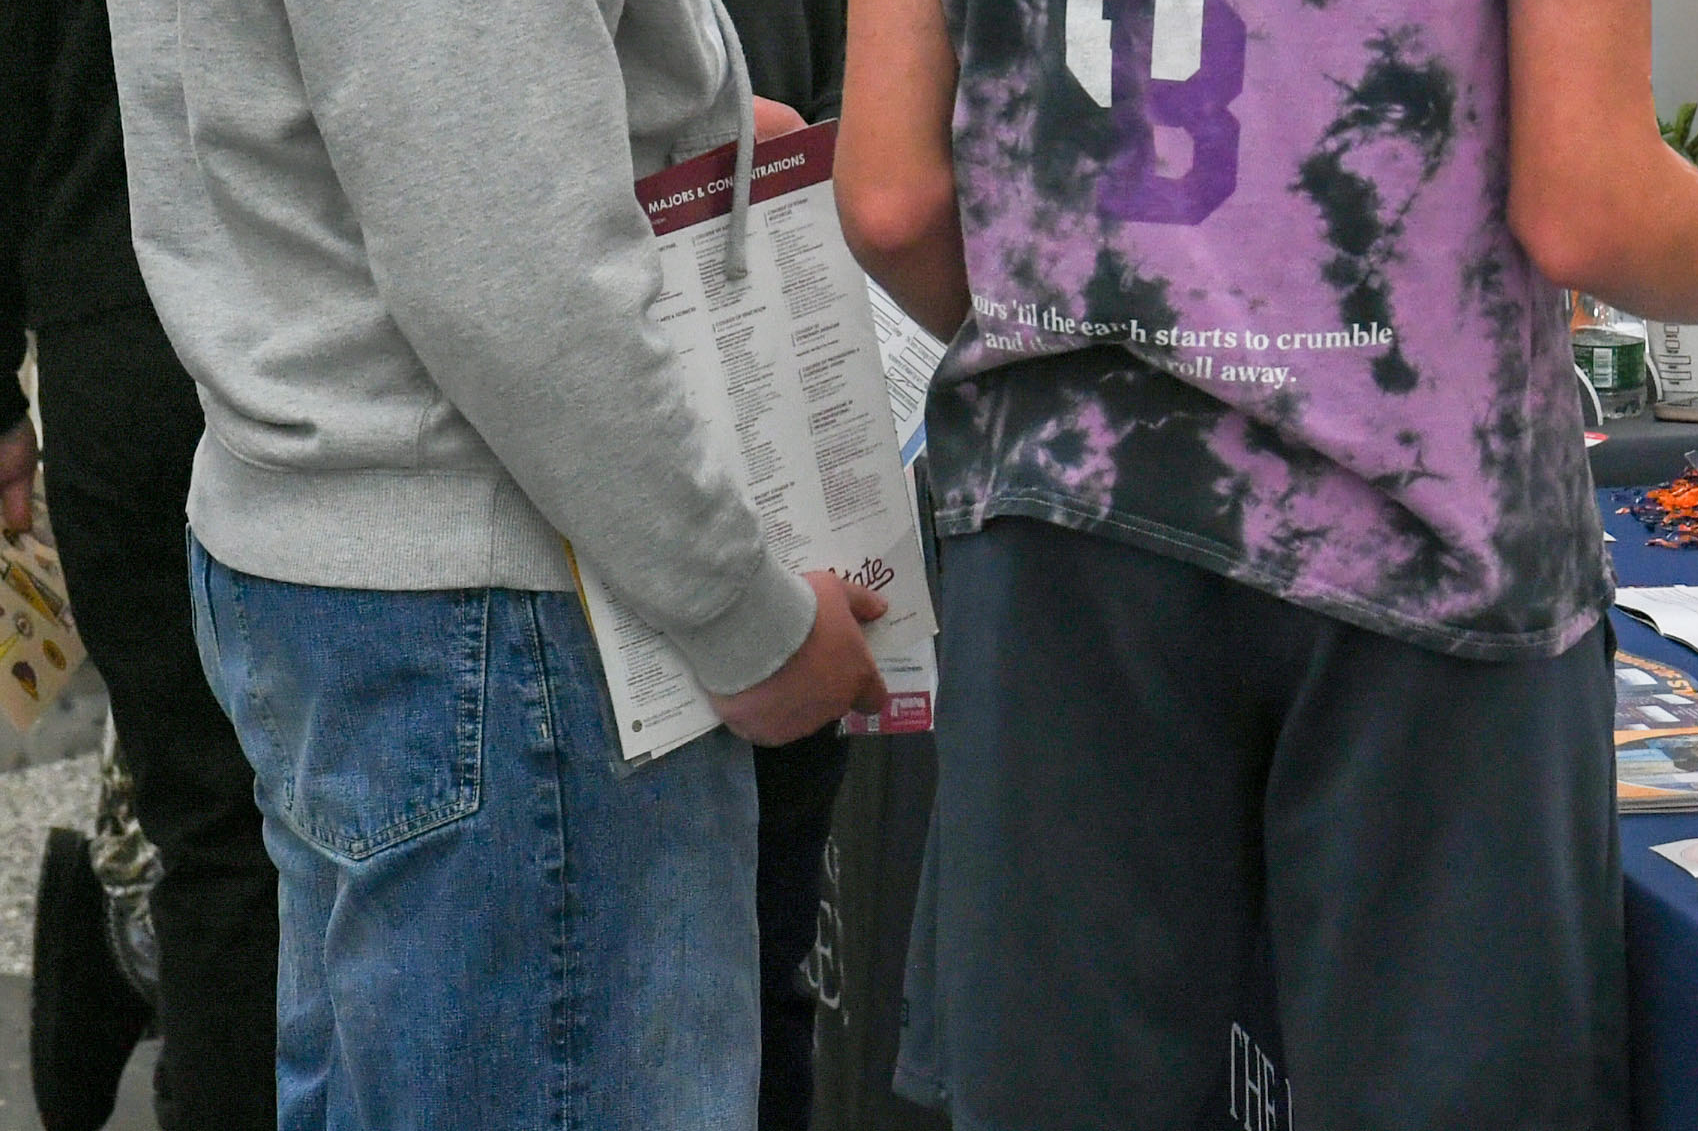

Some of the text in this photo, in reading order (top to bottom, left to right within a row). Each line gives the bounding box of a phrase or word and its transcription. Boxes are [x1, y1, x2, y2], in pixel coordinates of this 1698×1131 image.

[649, 153, 806, 214] MAJORS & CONNTRATIONS
[1043, 307, 1076, 335] the
[1153, 327, 1238, 350] starts
[1245, 326, 1270, 350] to
[1276, 322, 1394, 350] crumble
[985, 332, 1025, 352] and
[1221, 358, 1297, 389] away.
